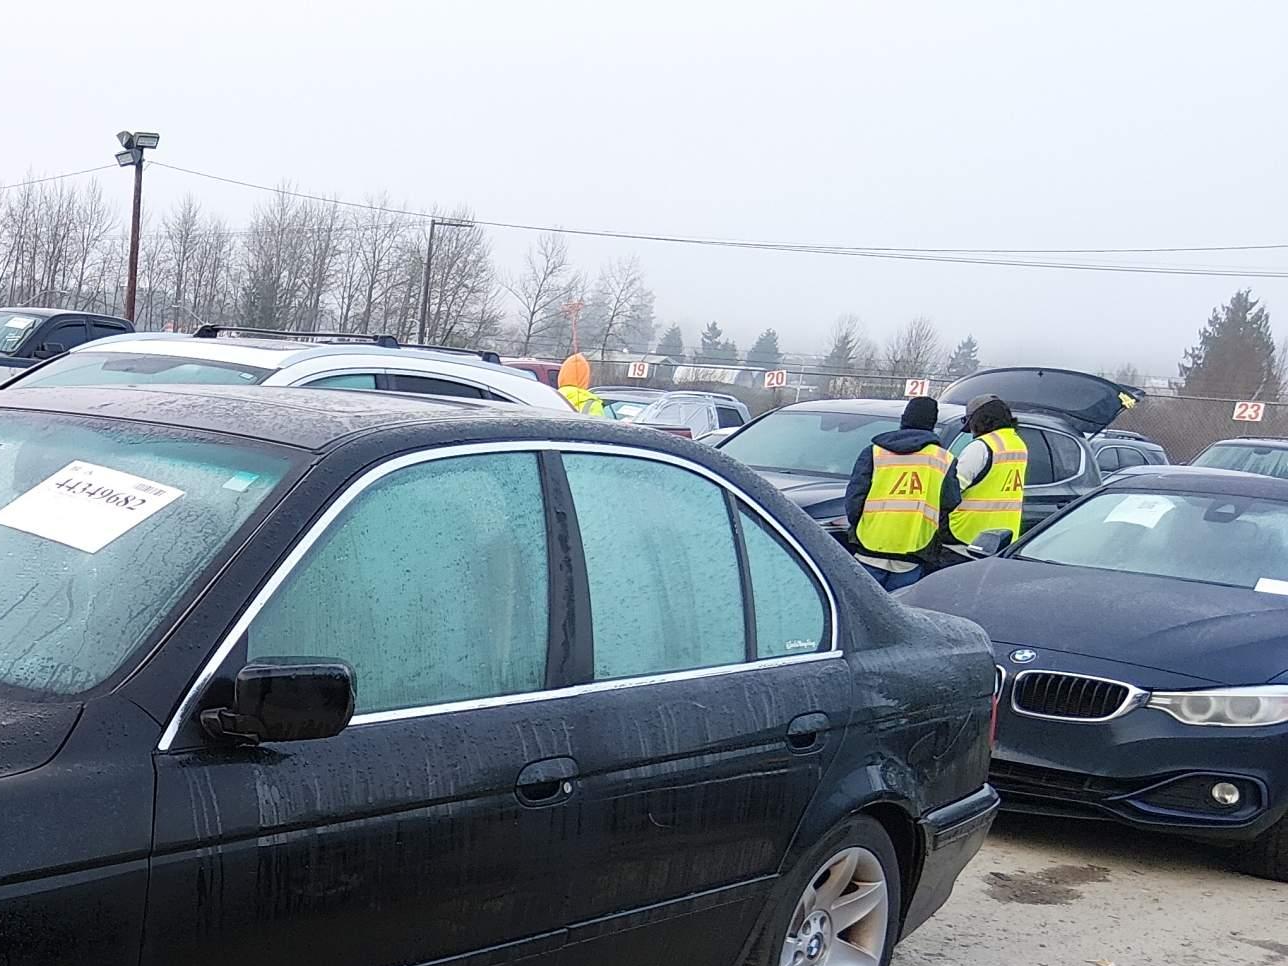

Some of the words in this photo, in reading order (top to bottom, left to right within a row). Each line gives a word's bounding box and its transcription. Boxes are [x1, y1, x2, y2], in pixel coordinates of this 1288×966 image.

[632, 363, 645, 376] 19
[767, 371, 784, 385] 20
[909, 380, 925, 395] 21
[1235, 403, 1261, 419] 23
[55, 478, 147, 511] 44349682
